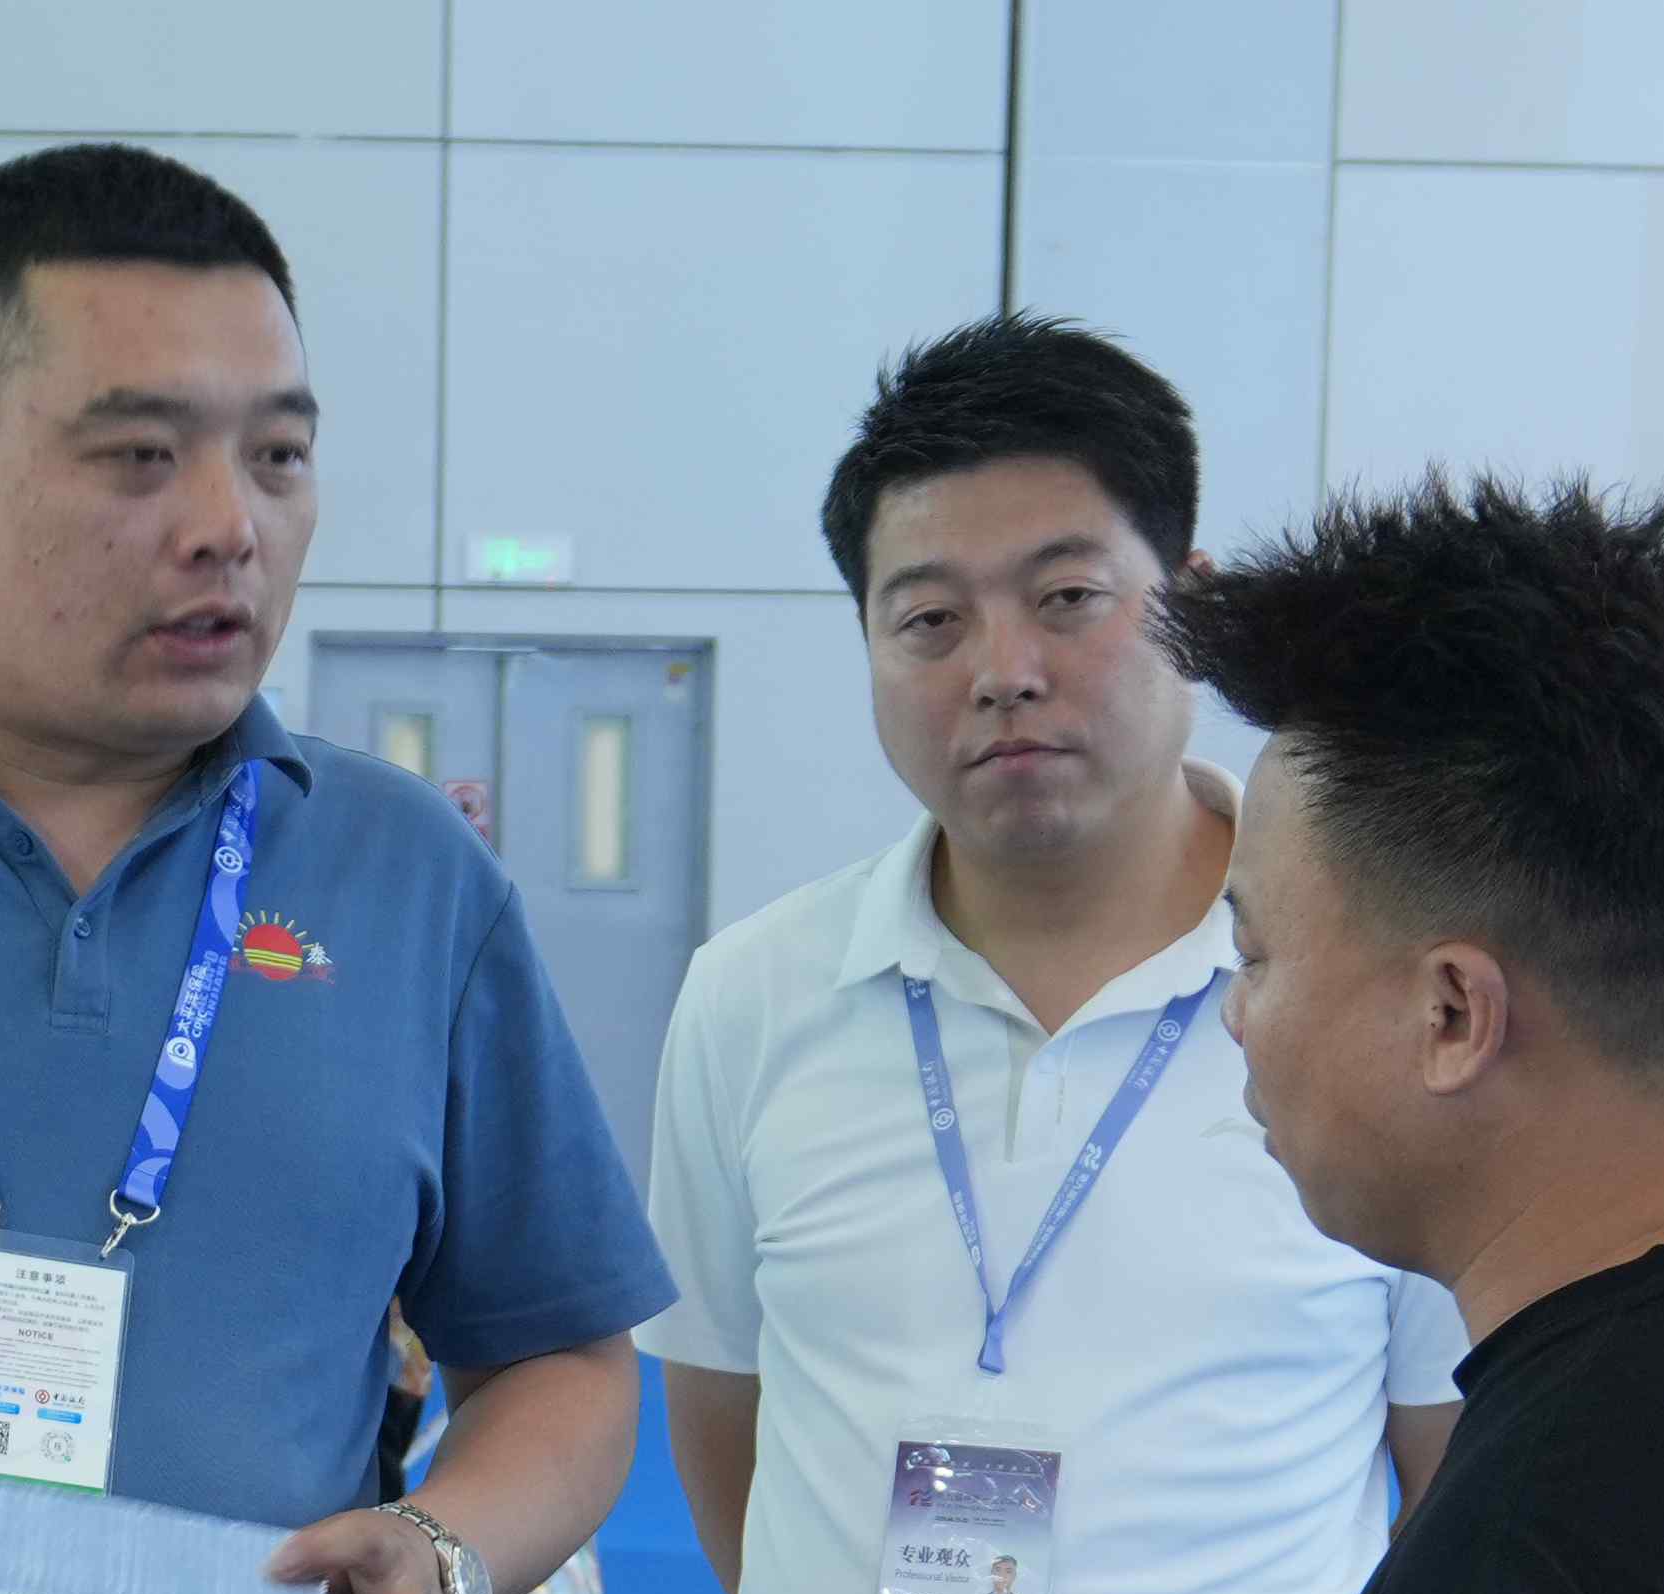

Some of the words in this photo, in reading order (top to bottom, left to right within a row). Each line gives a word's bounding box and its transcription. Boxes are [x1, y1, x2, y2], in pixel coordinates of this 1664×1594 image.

[191, 1008, 207, 1038] CPIC
[16, 1268, 66, 1285] 注意事项
[18, 1328, 54, 1341] NOTICE
[898, 1545, 970, 1568] 专业观众
